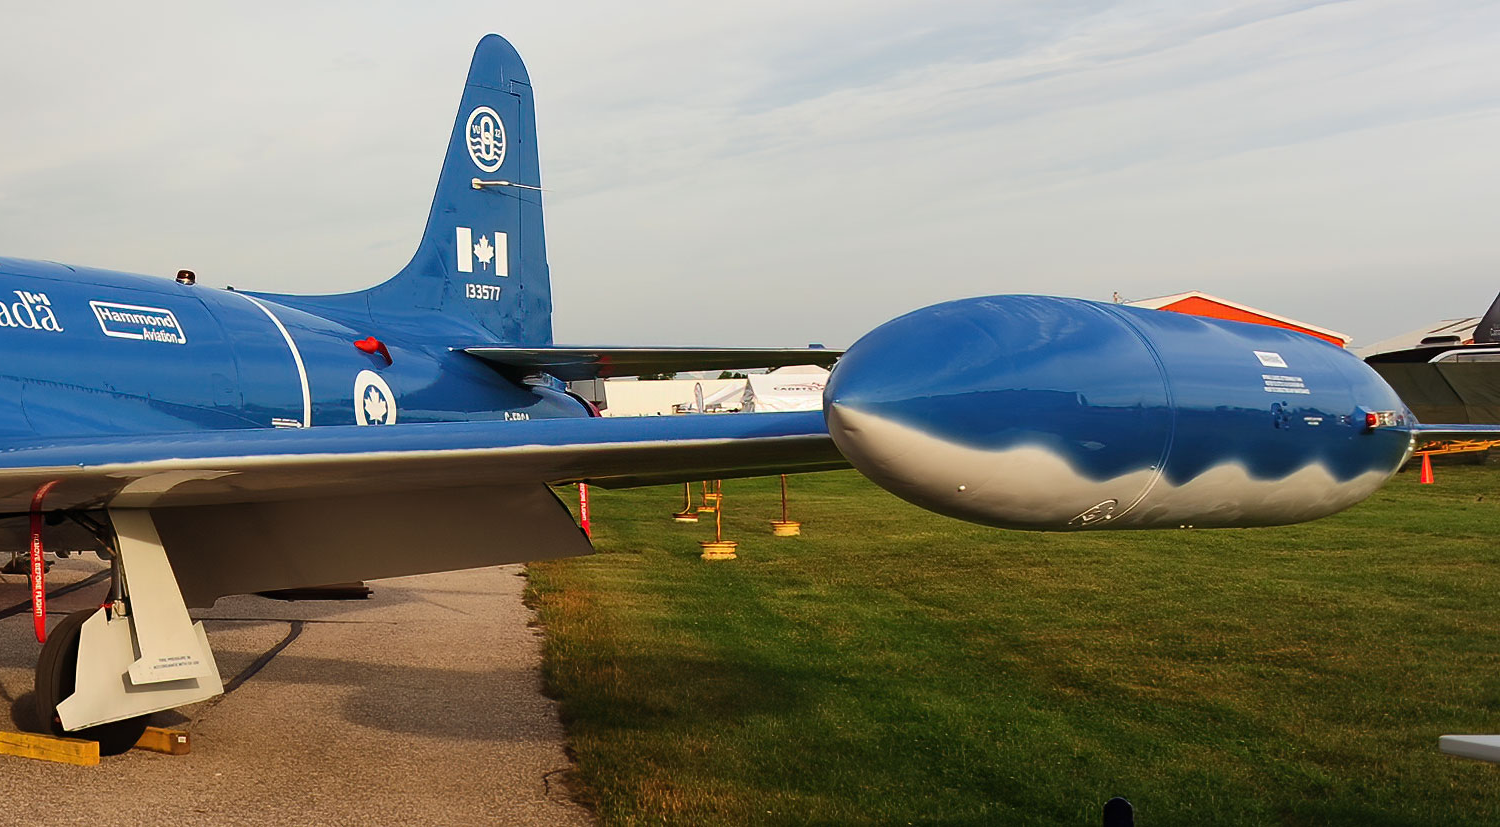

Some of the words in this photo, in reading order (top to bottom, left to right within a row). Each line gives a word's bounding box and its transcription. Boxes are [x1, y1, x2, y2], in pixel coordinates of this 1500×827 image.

[465, 283, 501, 301] 133577
[98, 307, 176, 328] Hammond
[142, 327, 179, 344] Aviation
[34, 563, 42, 590] BEFORE
[35, 591, 43, 617] FLIGHT
